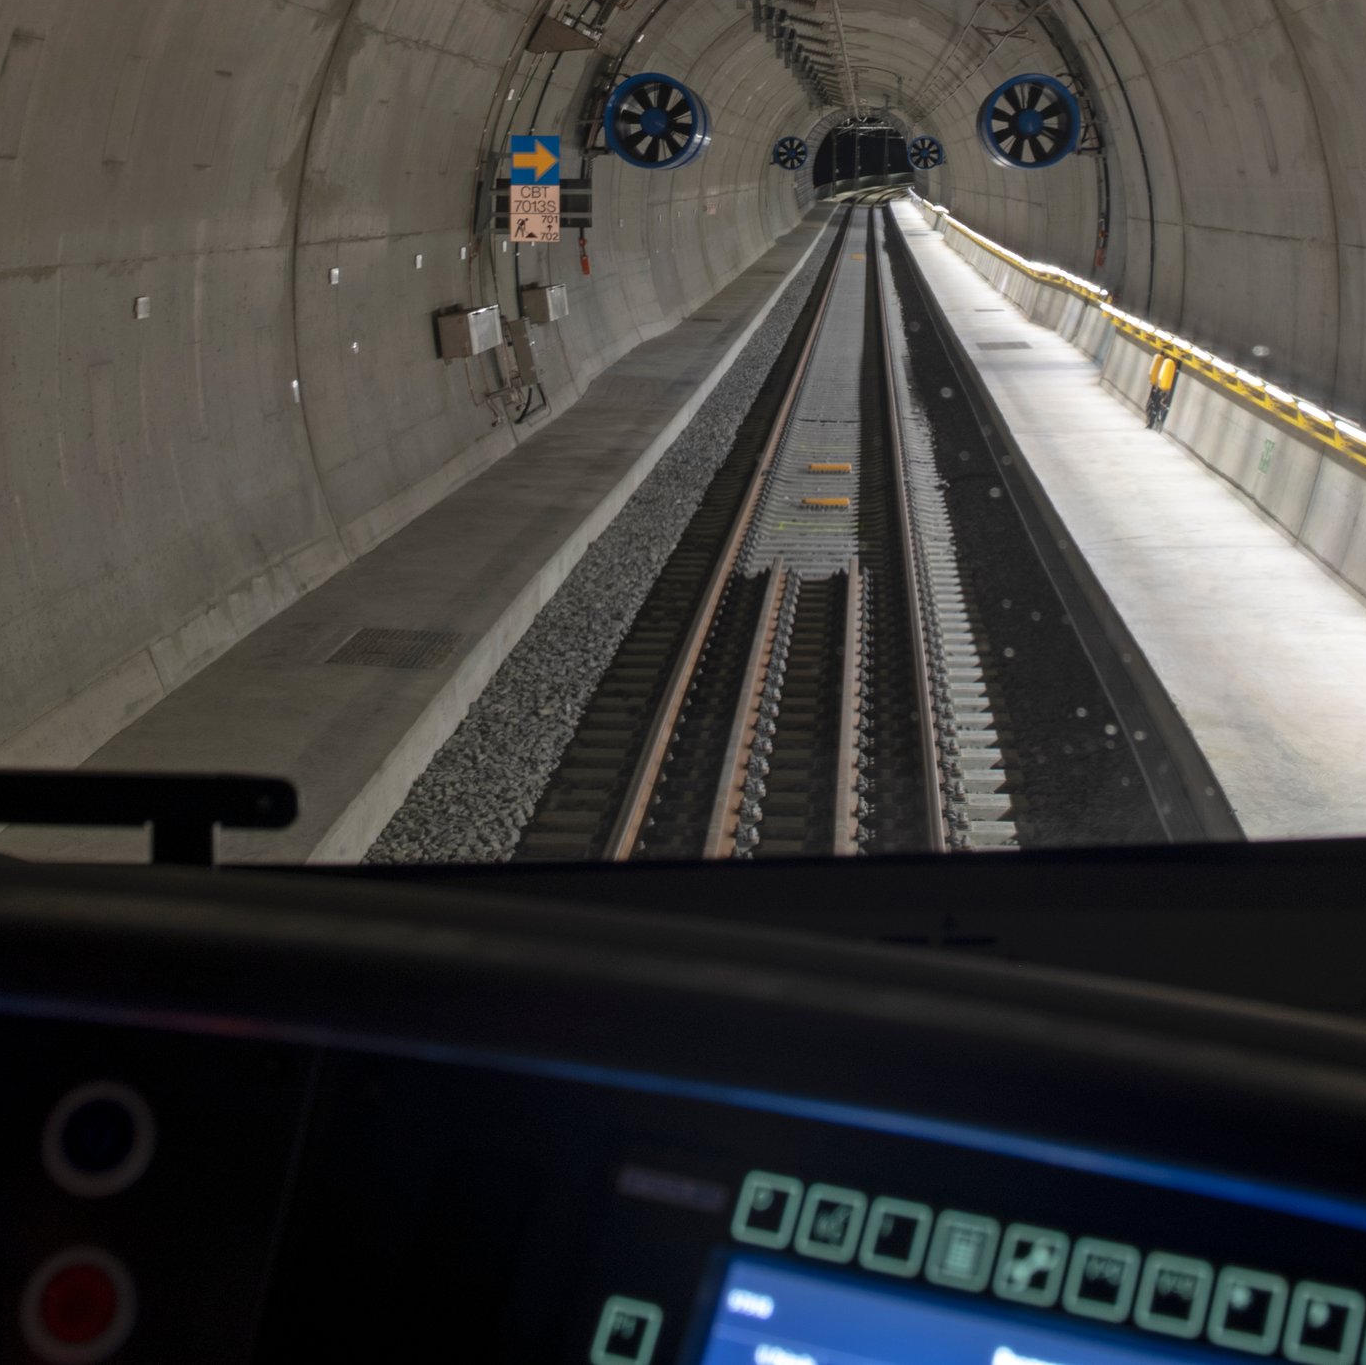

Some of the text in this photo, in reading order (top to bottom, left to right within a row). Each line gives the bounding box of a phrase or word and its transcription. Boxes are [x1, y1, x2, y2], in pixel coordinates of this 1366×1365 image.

[520, 186, 549, 198] CBT
[514, 200, 557, 213] 7013S
[541, 215, 558, 224] 701
[540, 232, 559, 241] 702
